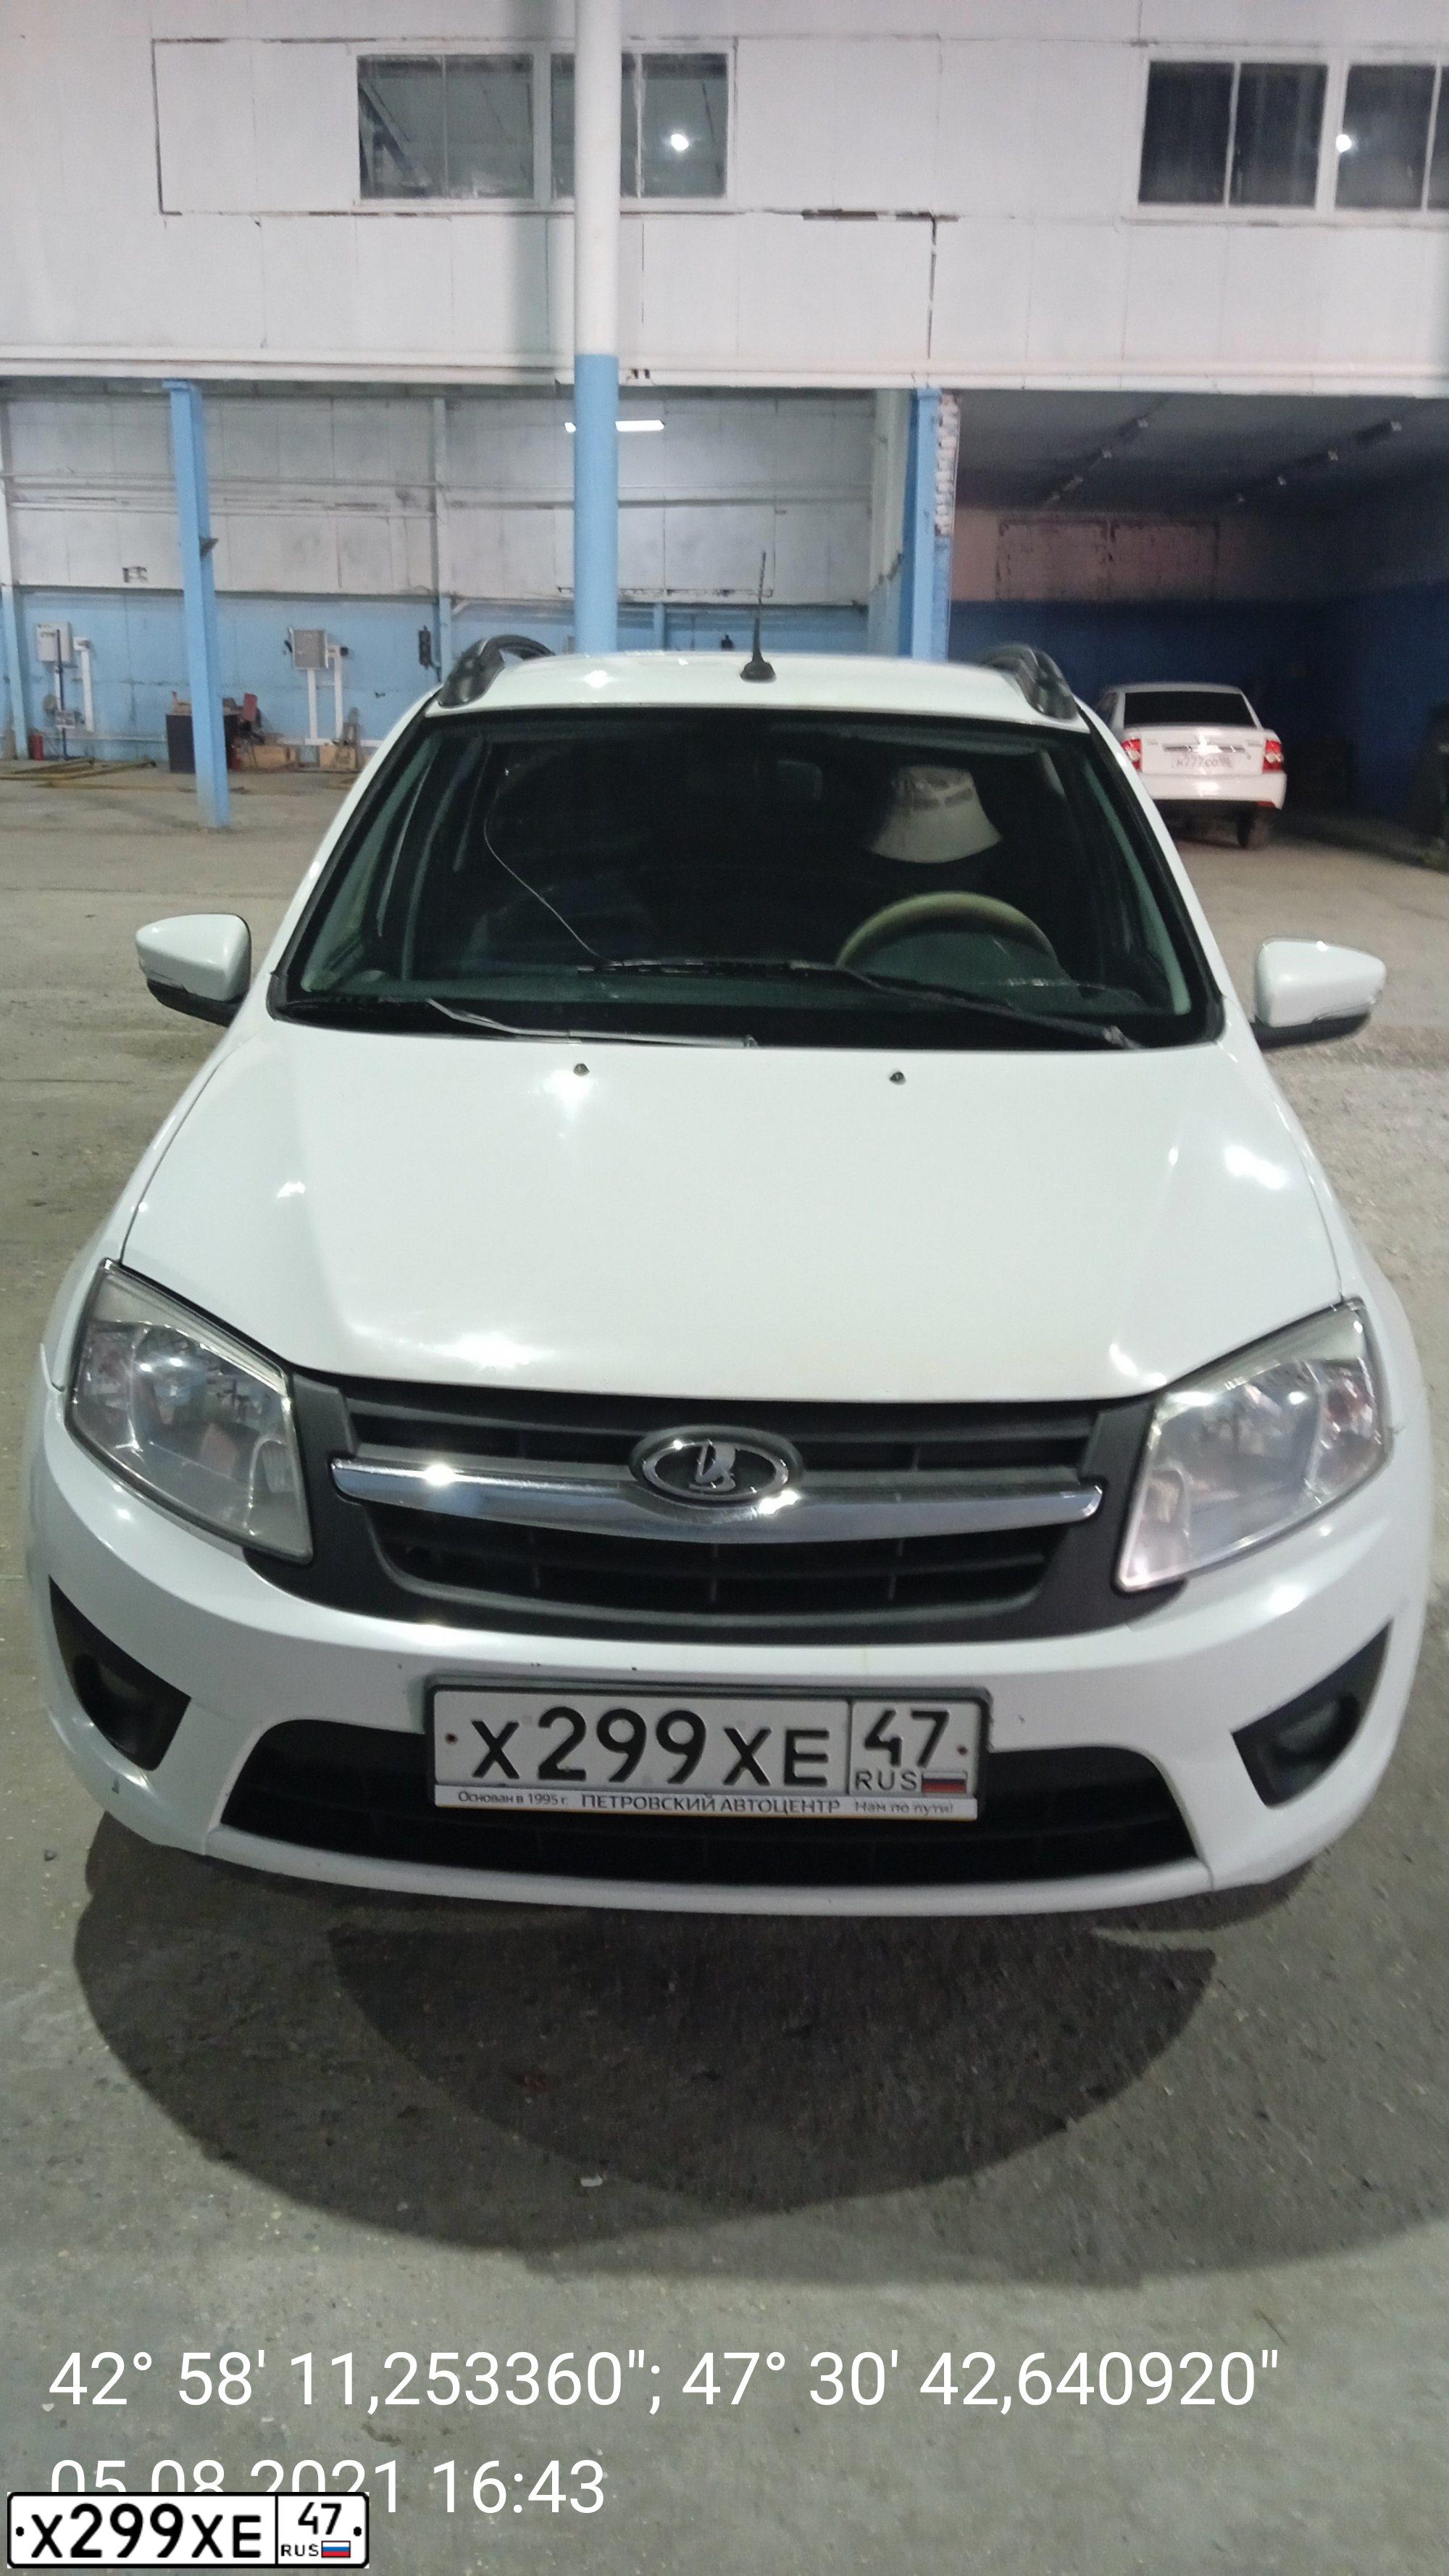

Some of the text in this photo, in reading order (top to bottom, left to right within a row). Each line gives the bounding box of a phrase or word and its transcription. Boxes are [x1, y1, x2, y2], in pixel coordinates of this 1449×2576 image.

[864, 1709, 950, 1768] 47
[855, 1770, 917, 1791] RUS
[458, 1791, 514, 1804] Основан
[528, 1793, 558, 1805] 1995
[582, 1793, 716, 1811] ПЕТРОВСКИЙ
[720, 1798, 840, 1814] АВТОЦЕНТР
[855, 1801, 886, 1812] Нам
[891, 1803, 909, 1812] по
